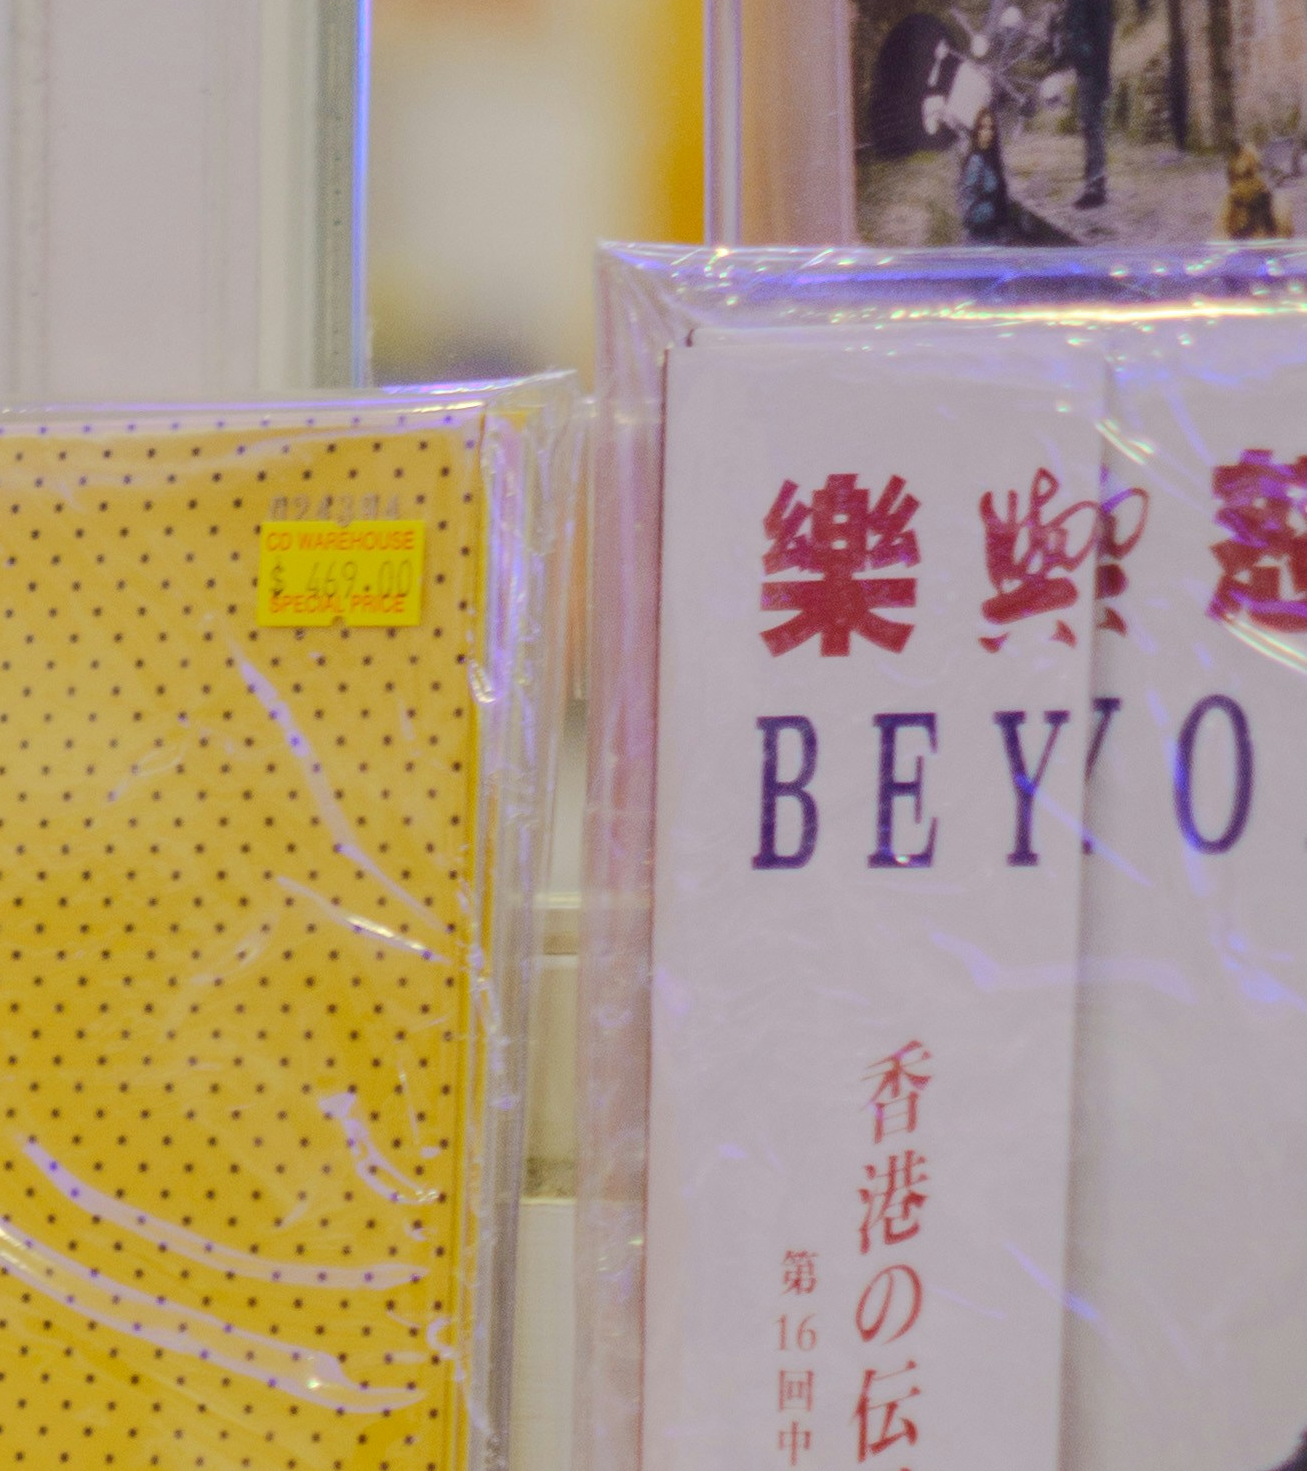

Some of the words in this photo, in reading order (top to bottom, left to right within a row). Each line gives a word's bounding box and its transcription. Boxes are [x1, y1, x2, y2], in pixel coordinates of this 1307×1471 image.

[297, 530, 415, 552] WAREHOUSE
[268, 593, 345, 615] SPECIAL
[350, 593, 406, 615] PRICE
[751, 693, 1307, 872] BEYO
